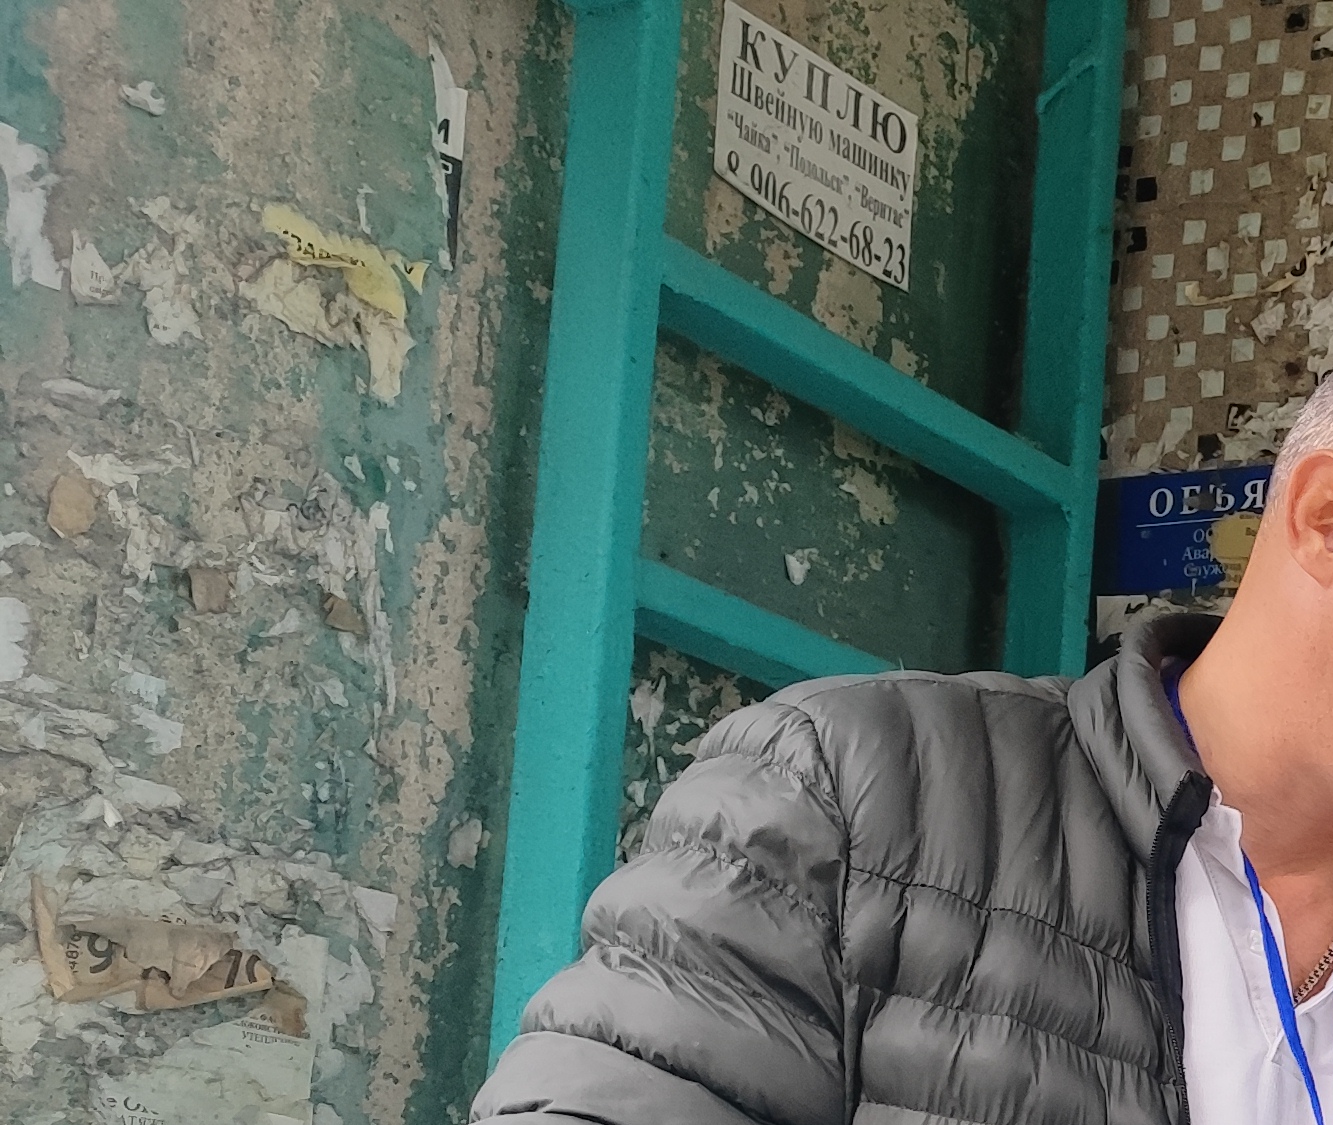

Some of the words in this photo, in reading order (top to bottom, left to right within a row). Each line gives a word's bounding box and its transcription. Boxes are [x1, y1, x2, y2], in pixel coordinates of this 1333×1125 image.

[731, 61, 823, 144] Швейную
[829, 128, 910, 201] машинку
[737, 18, 907, 154] КУПЛЮ
[750, 162, 906, 285] 906-622-68-23
